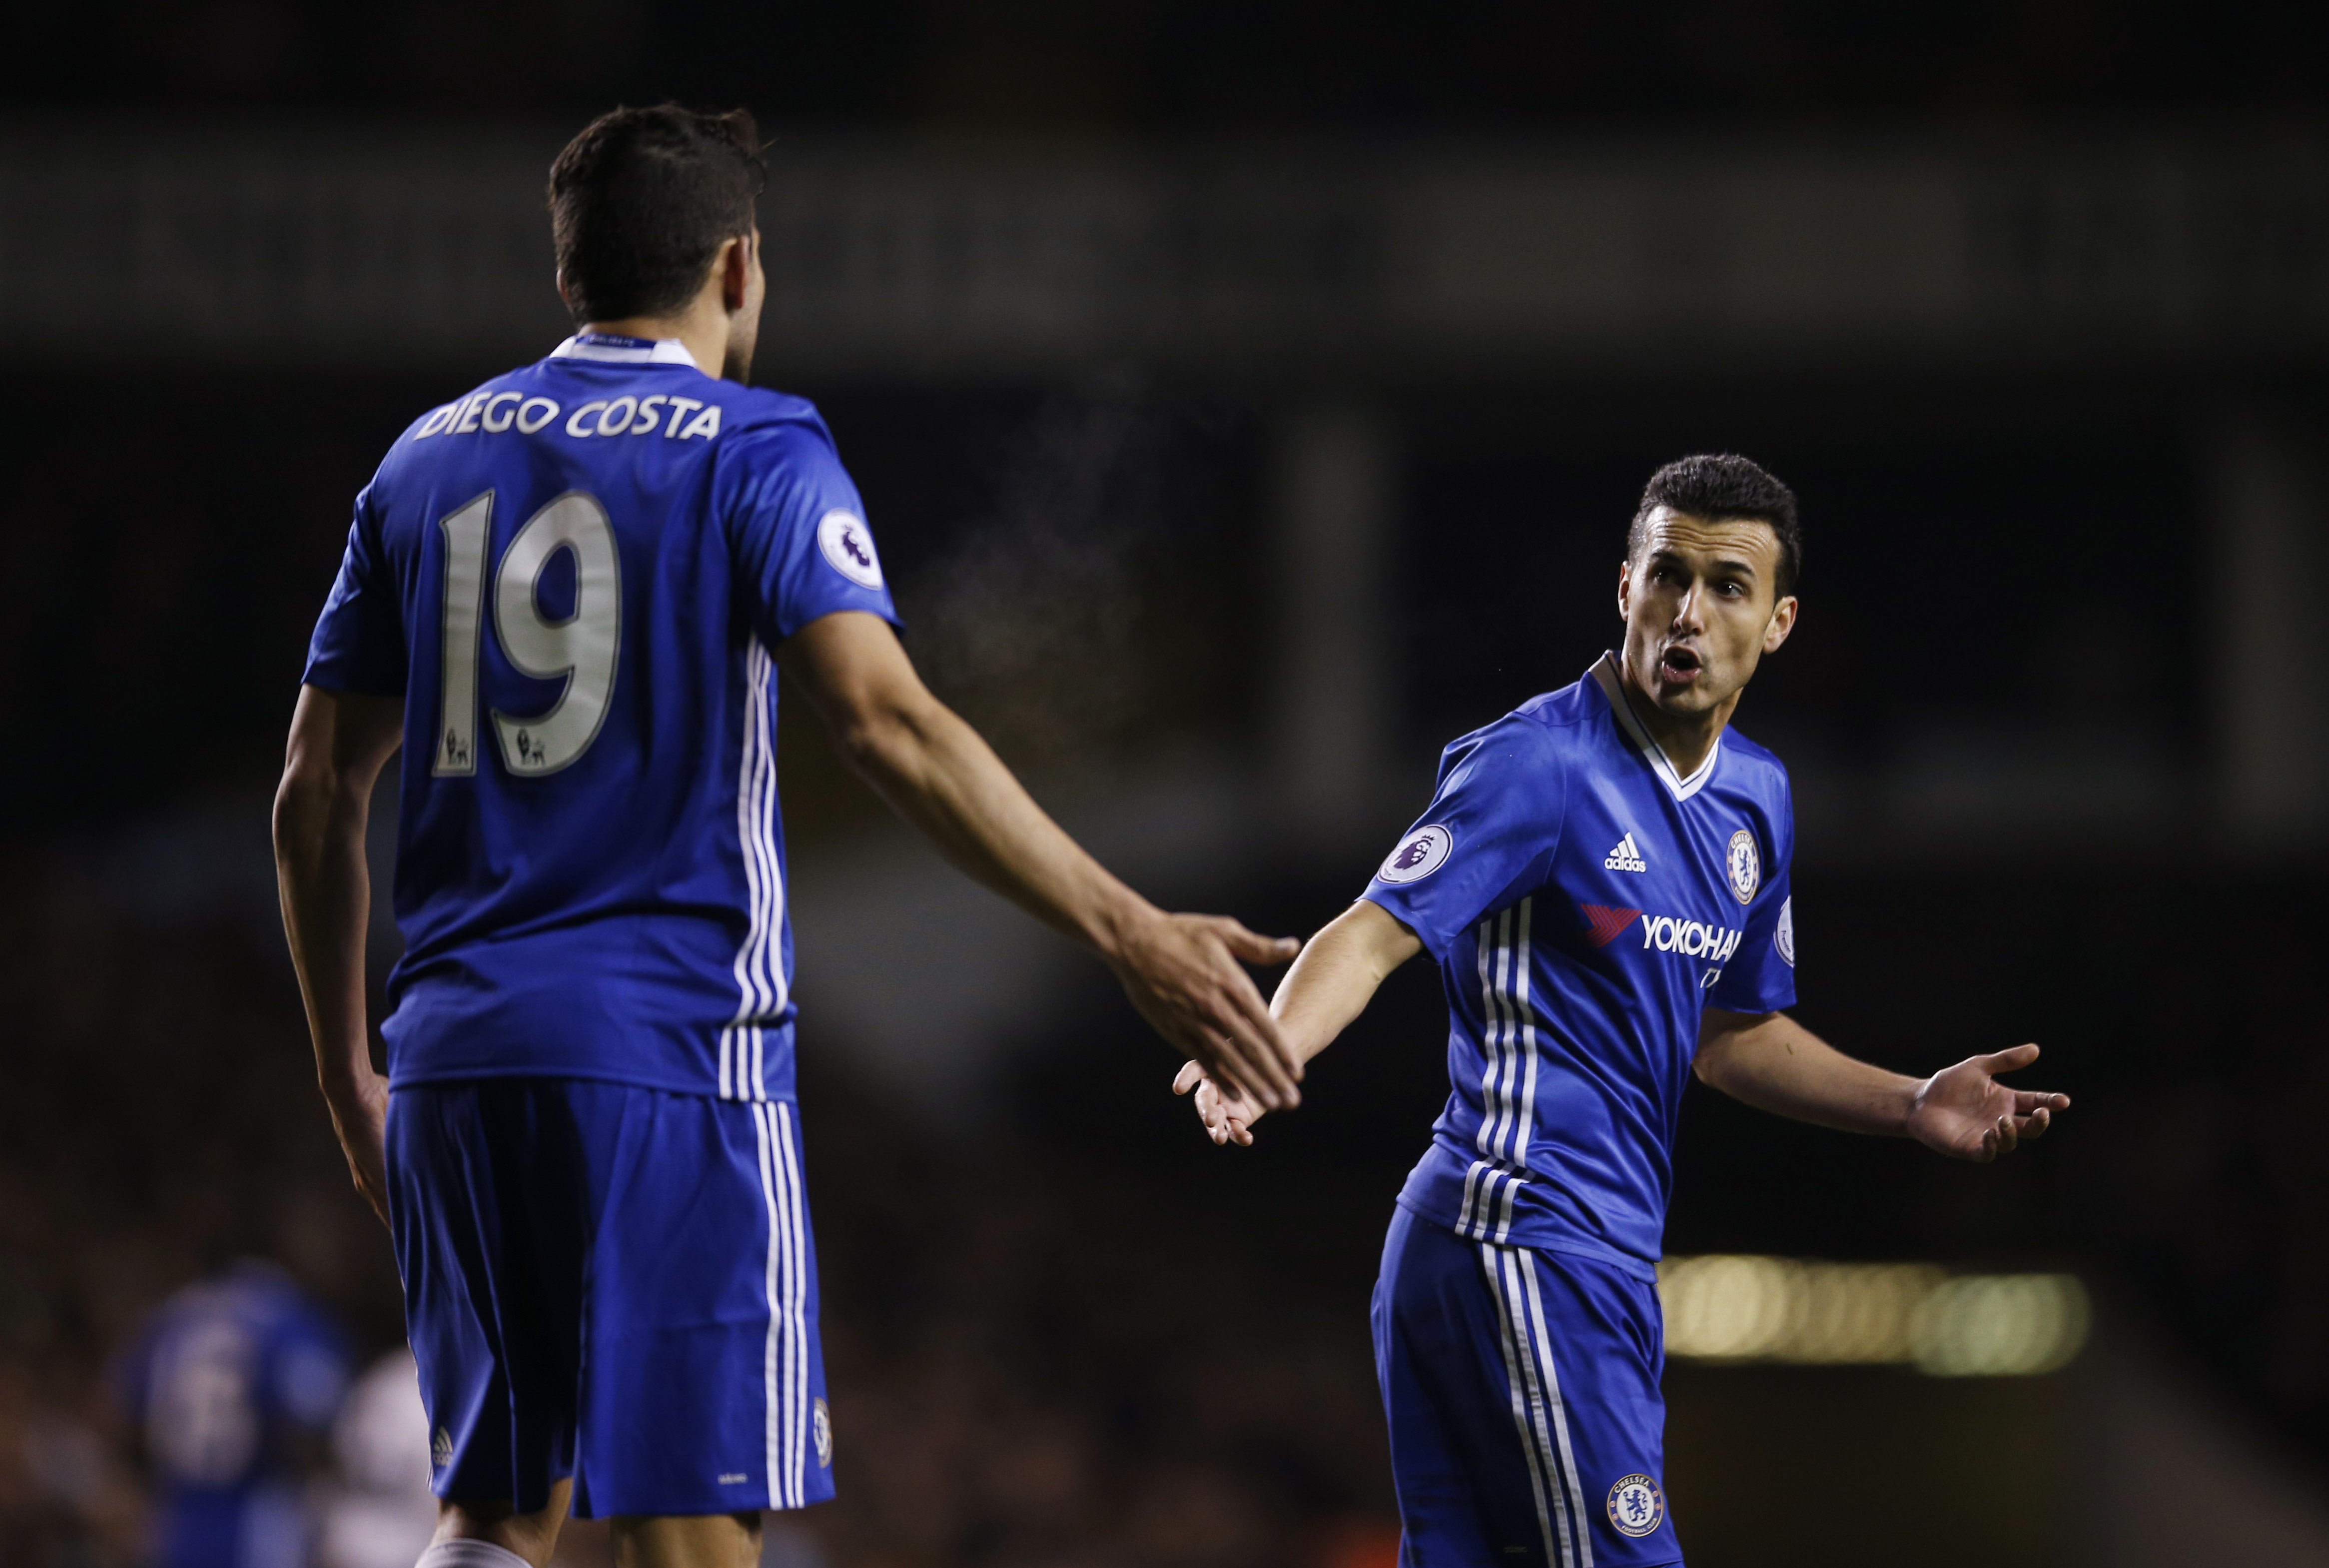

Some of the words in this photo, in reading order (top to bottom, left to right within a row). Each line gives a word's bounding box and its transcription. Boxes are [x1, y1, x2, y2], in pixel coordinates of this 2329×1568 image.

[414, 391, 560, 440] DIEGO
[565, 395, 722, 441] COSTA
[431, 488, 623, 777] 19
[1604, 857, 1646, 873] adidas
[1614, 1476, 1649, 1494] CHELSEA
